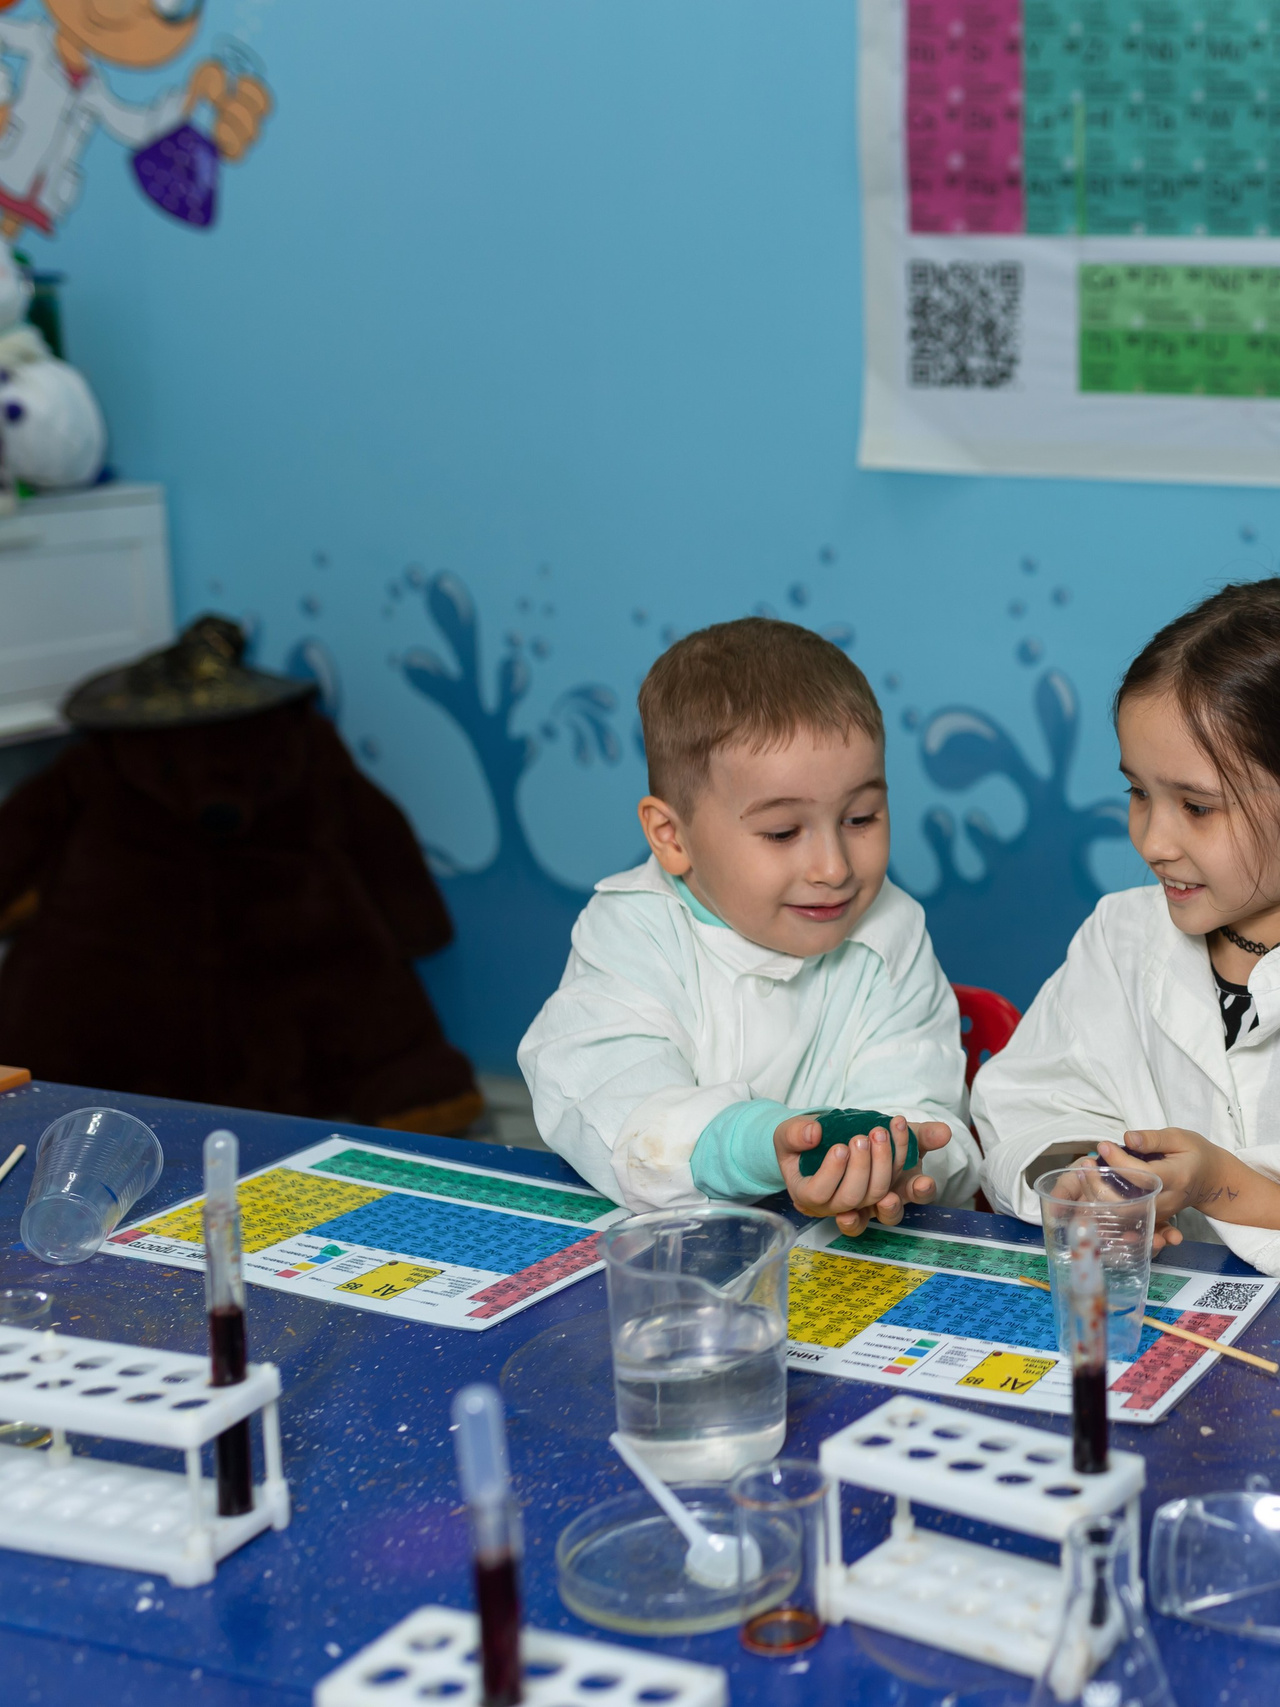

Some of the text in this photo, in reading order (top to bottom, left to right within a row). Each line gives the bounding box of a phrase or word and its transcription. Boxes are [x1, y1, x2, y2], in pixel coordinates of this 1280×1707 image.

[340, 1280, 407, 1298] At 85
[965, 1376, 1032, 1391] At 85
